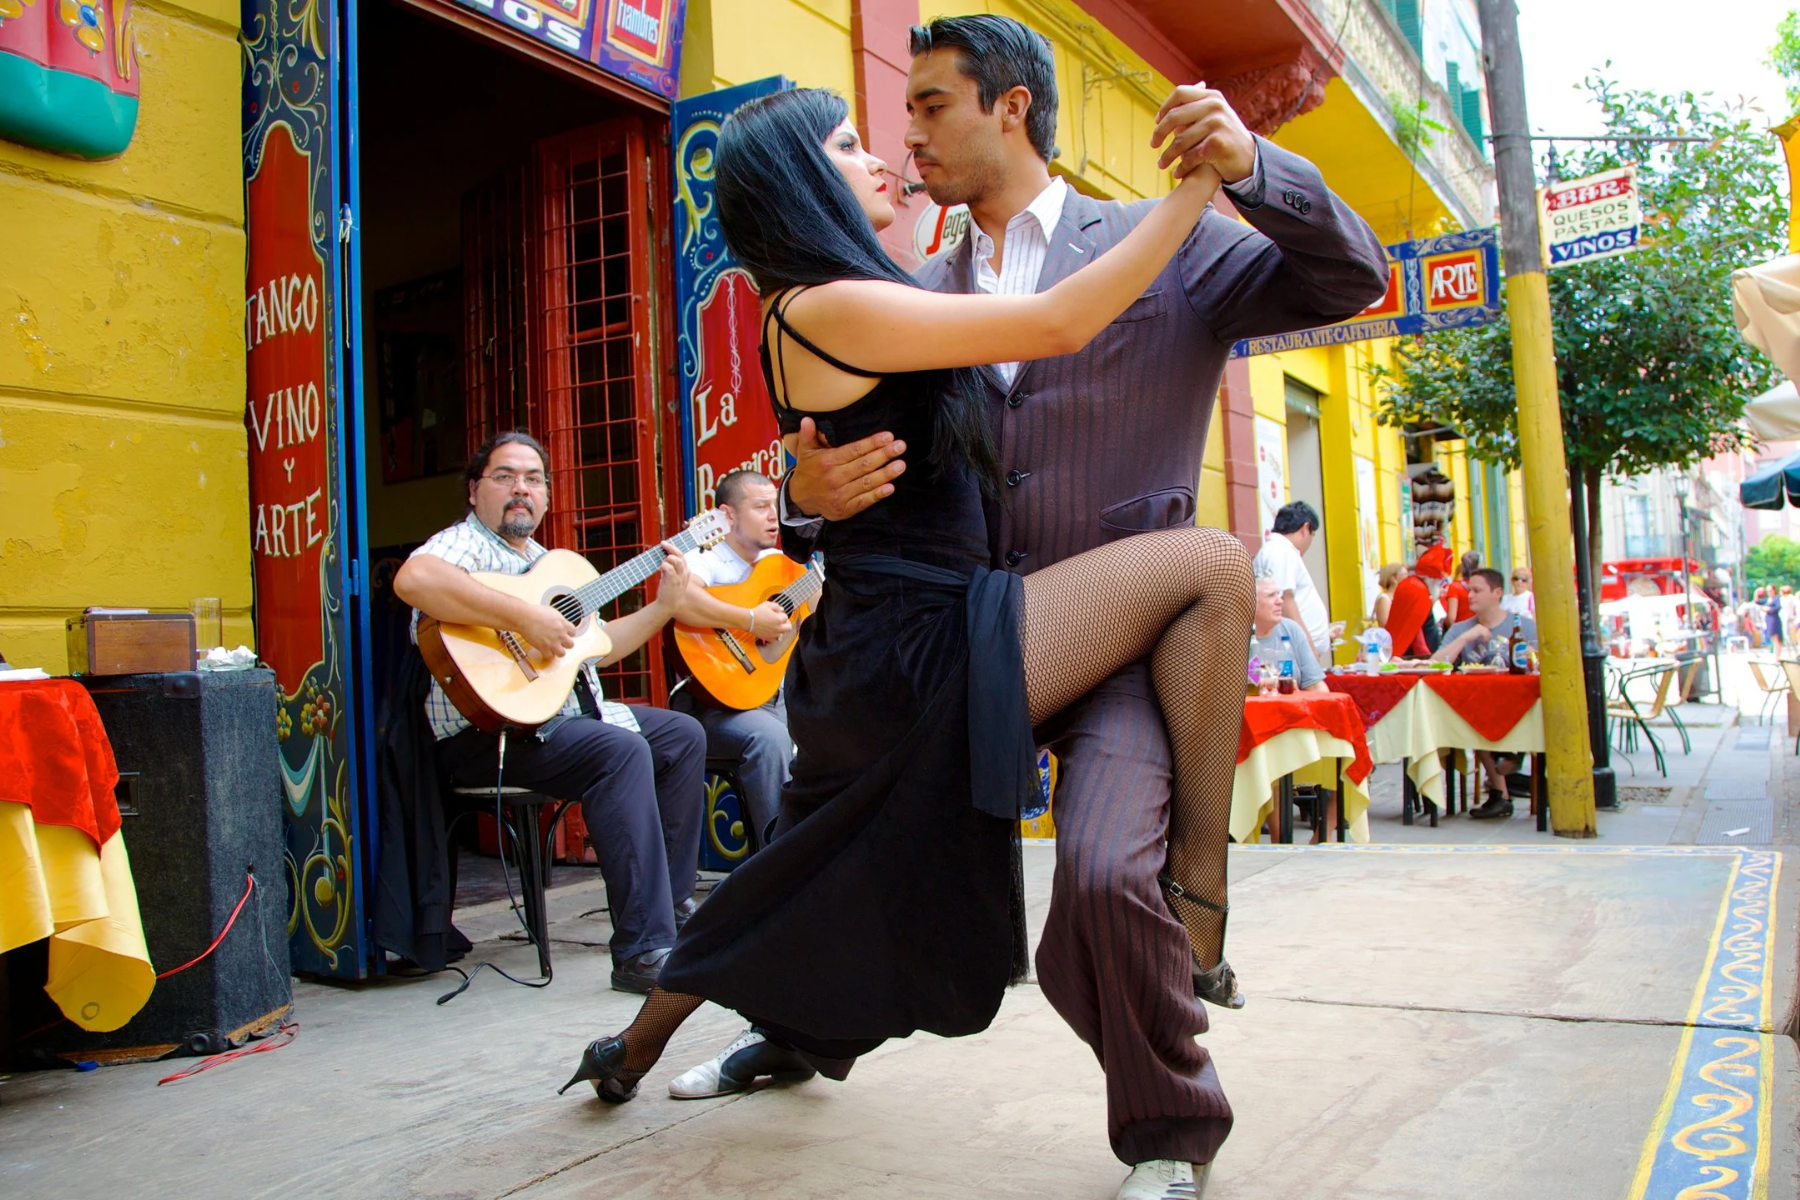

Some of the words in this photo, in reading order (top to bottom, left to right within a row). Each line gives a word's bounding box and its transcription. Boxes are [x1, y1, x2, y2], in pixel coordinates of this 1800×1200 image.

[1557, 181, 1620, 208] BAR
[1554, 200, 1628, 226] QUESOS
[1555, 213, 1629, 239] PASTAS
[1556, 231, 1631, 259] VINOS
[1430, 262, 1478, 300] ARTE
[246, 272, 318, 352] TANGO
[250, 381, 320, 452] VINO
[696, 384, 738, 447] La
[283, 457, 295, 483] Y
[254, 487, 322, 557] ARTE
